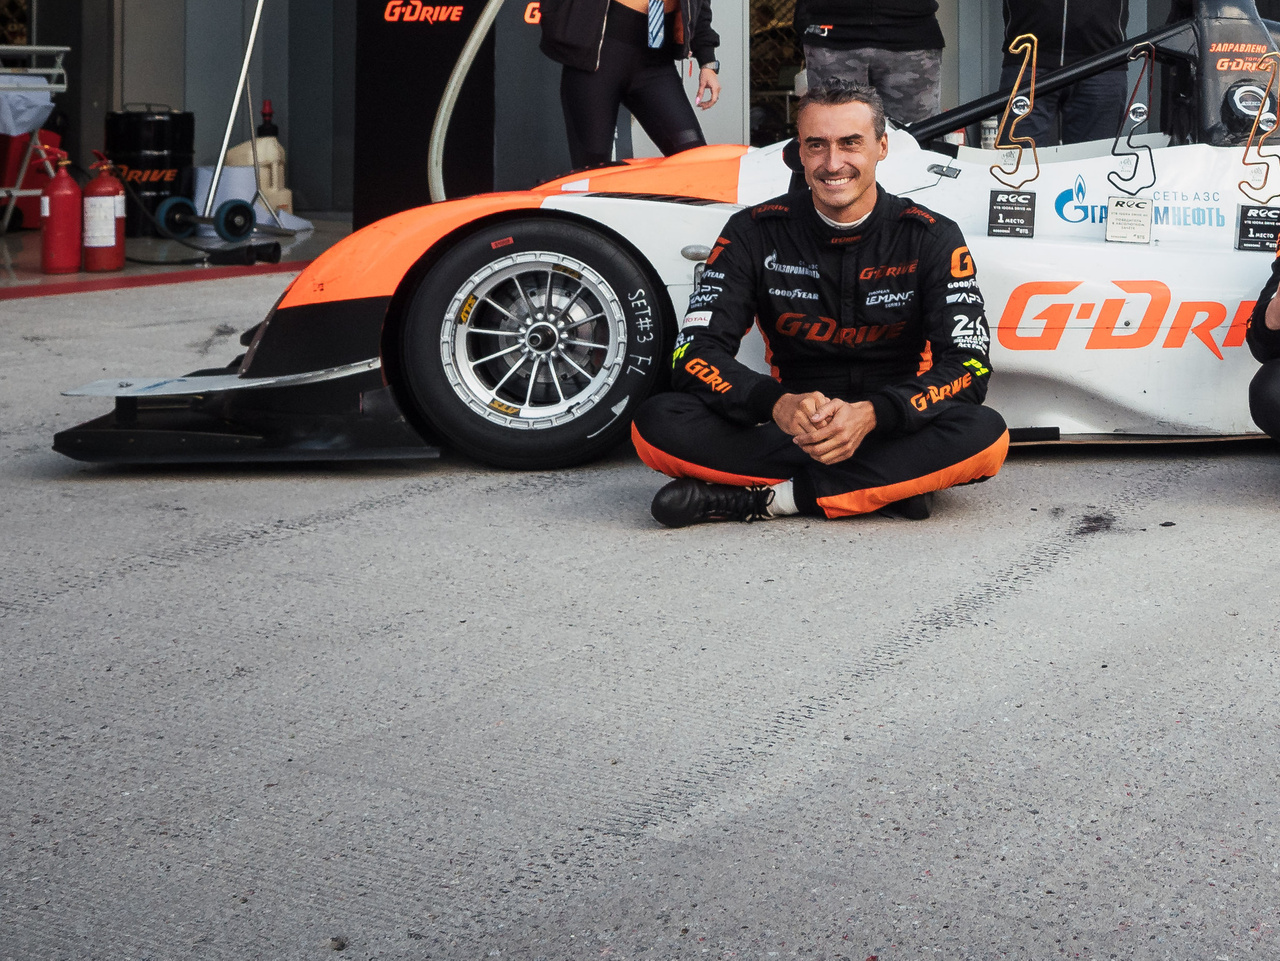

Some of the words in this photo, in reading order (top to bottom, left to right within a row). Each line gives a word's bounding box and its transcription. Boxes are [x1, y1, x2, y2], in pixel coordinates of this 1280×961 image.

[1209, 43, 1268, 54] ЗАПРАВЛЕНО
[1153, 191, 1189, 202] СЕТЬ
[1193, 191, 1220, 202] АЗС
[1091, 205, 1226, 228] ГАМНЕФТЬ
[997, 279, 1258, 361] G-DRI
